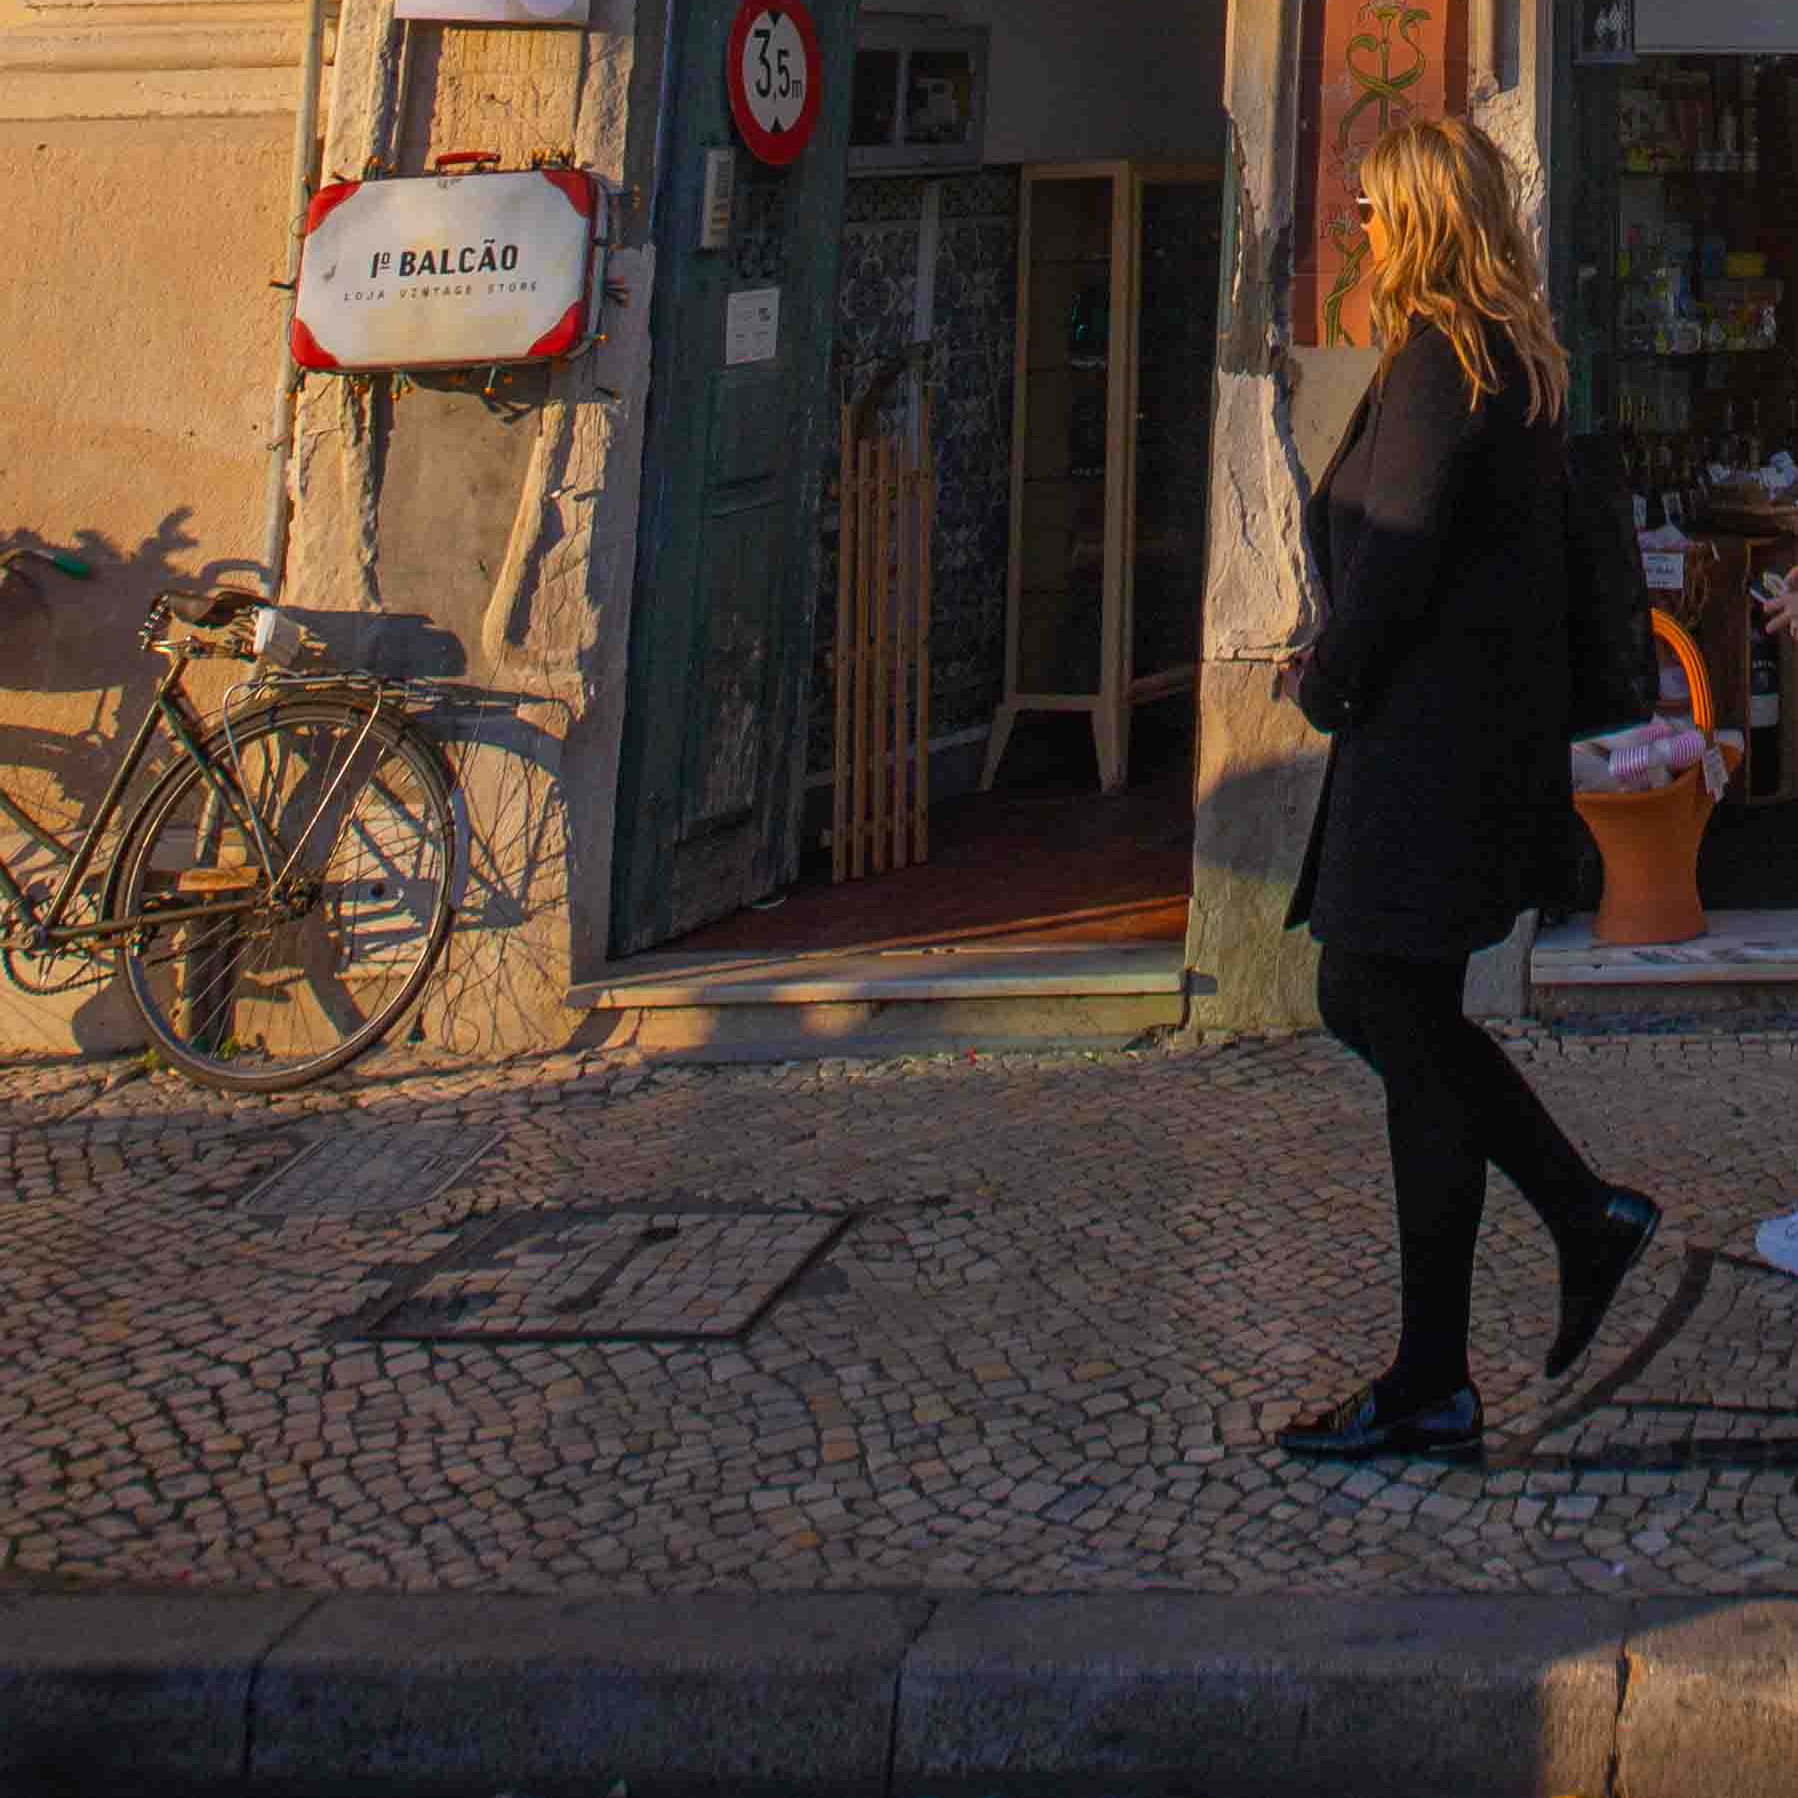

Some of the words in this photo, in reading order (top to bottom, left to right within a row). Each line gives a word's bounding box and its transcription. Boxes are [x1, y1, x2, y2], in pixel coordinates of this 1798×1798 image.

[399, 238, 519, 277] BALCÃO
[345, 290, 385, 301] LOJA
[399, 286, 473, 299] VINTAGE
